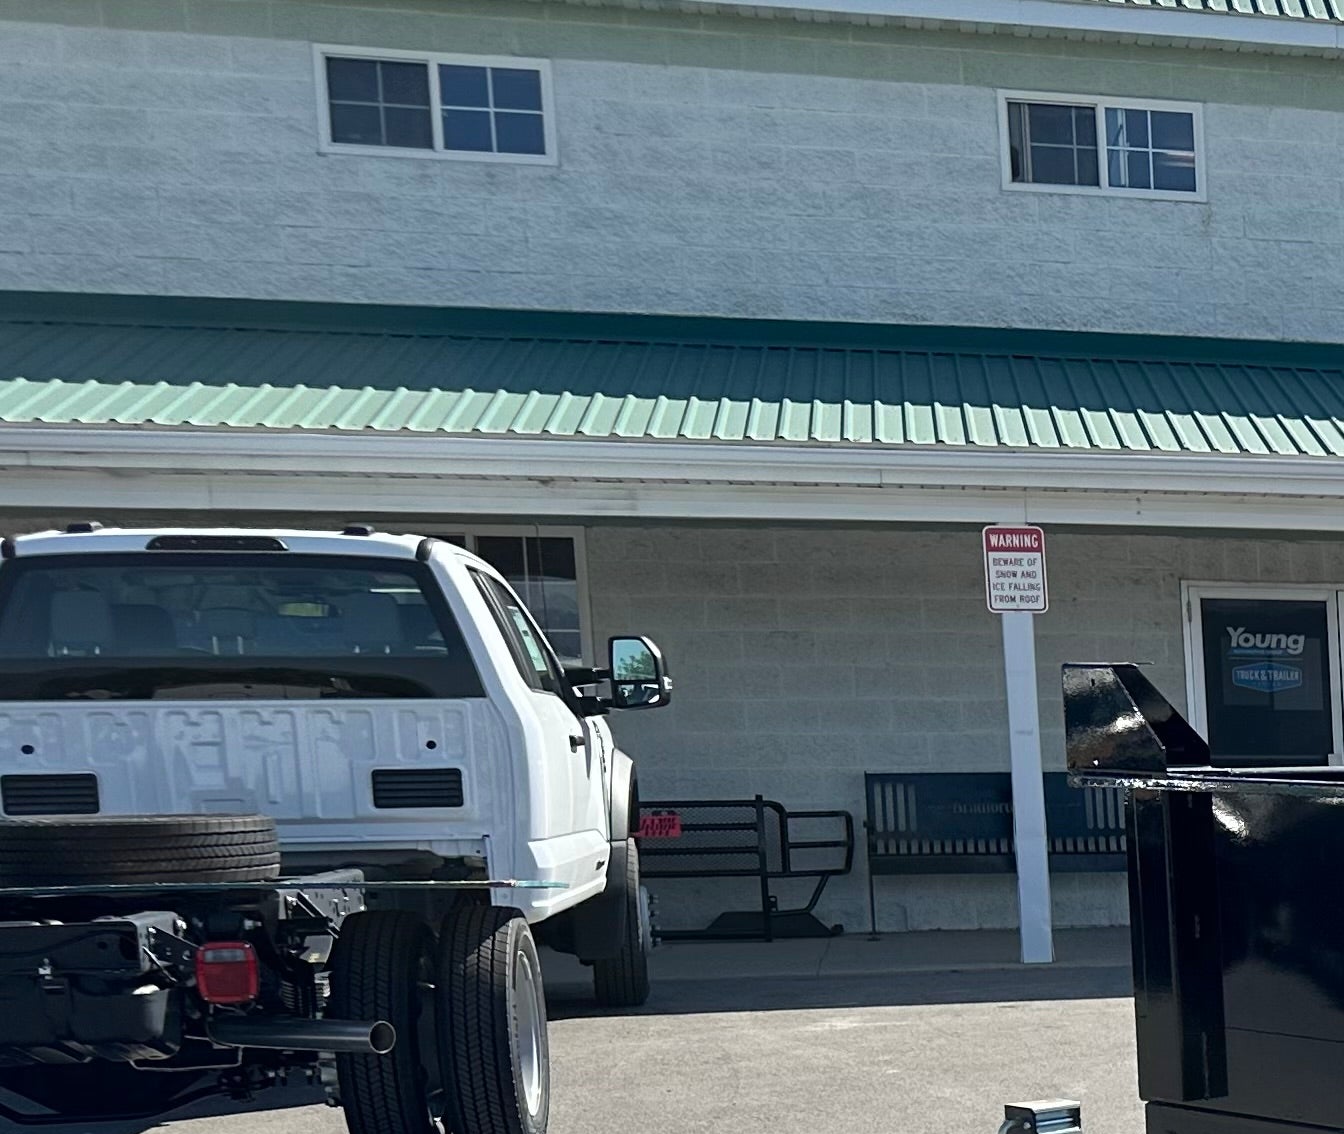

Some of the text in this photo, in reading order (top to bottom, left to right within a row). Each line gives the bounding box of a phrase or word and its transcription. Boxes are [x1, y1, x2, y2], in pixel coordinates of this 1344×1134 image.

[989, 533, 1039, 548] WARNING
[992, 557, 1037, 567] BEWARE OF
[995, 570, 1037, 579] SNOW AND
[992, 582, 1041, 592] ICE FALLING
[994, 594, 1041, 604] FROM ROOF
[1226, 626, 1305, 655] Young
